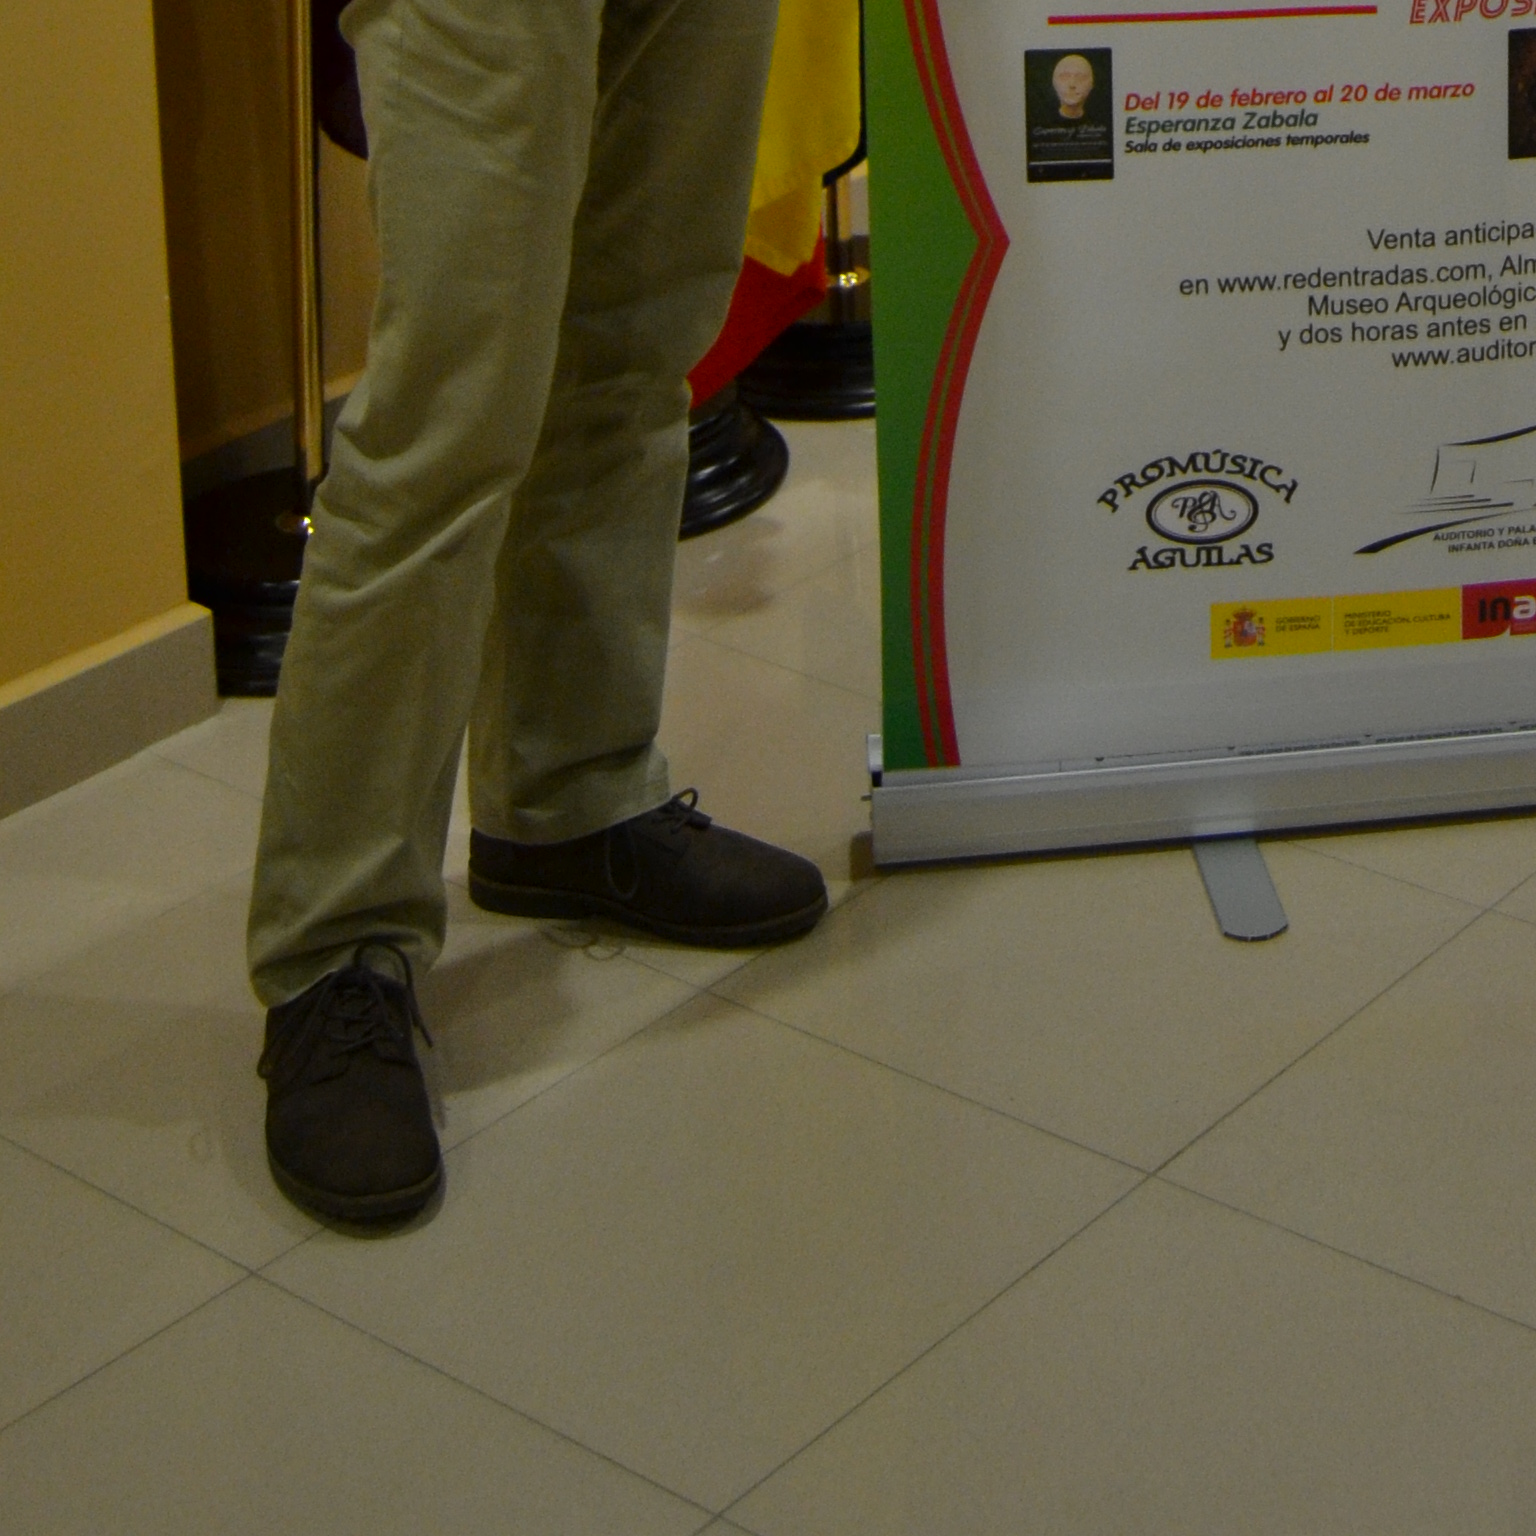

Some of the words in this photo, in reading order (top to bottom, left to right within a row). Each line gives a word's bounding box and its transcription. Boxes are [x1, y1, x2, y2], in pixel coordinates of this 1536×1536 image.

[1125, 117, 1235, 137] Esperanza
[1242, 109, 1318, 130] Zabala
[1367, 229, 1436, 251] Venta
[1097, 449, 1299, 513] PROMÚSICA
[1127, 542, 1275, 571] ÁGUILAS
